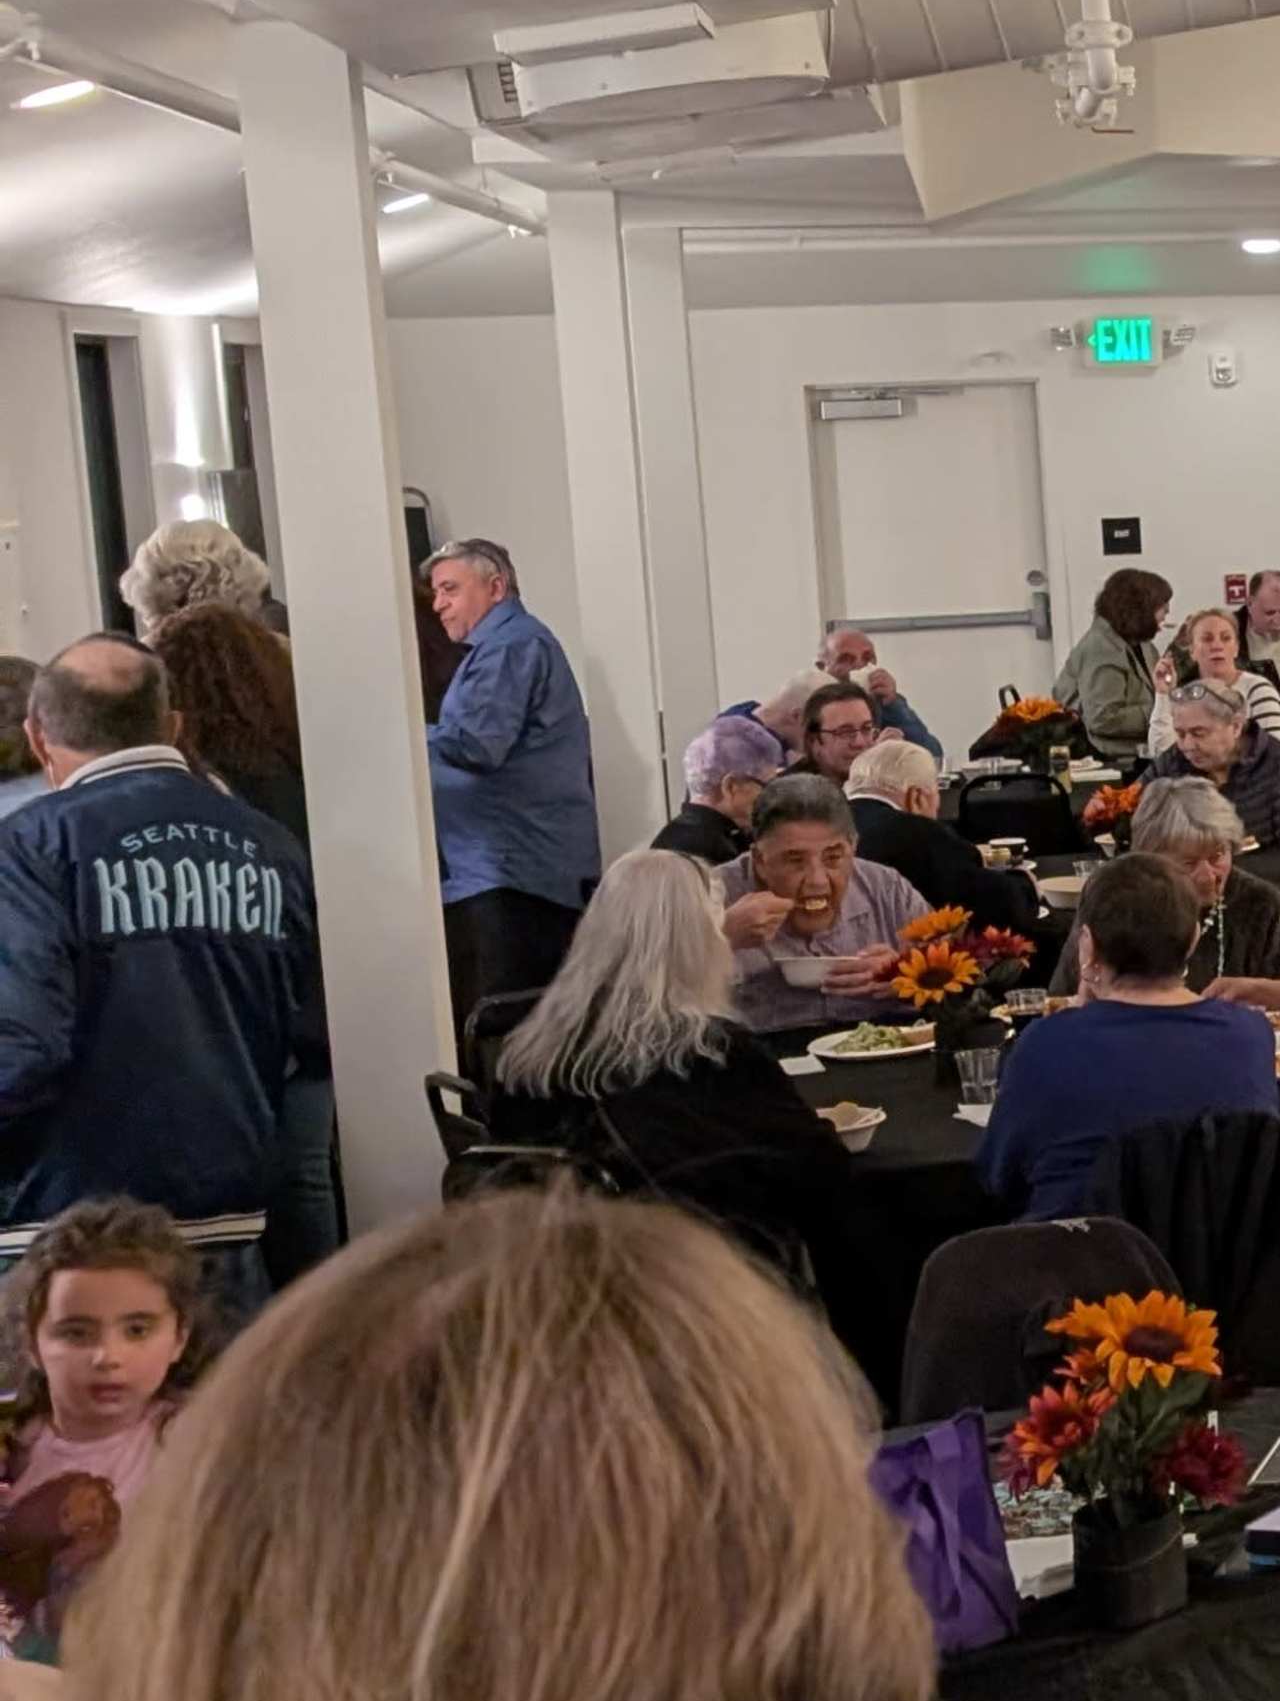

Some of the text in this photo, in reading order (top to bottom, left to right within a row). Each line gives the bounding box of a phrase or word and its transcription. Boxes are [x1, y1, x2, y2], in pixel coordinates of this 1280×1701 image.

[1097, 319, 1151, 361] EXIT
[120, 823, 257, 859] SEATTLE
[94, 856, 282, 940] KRAKEN
